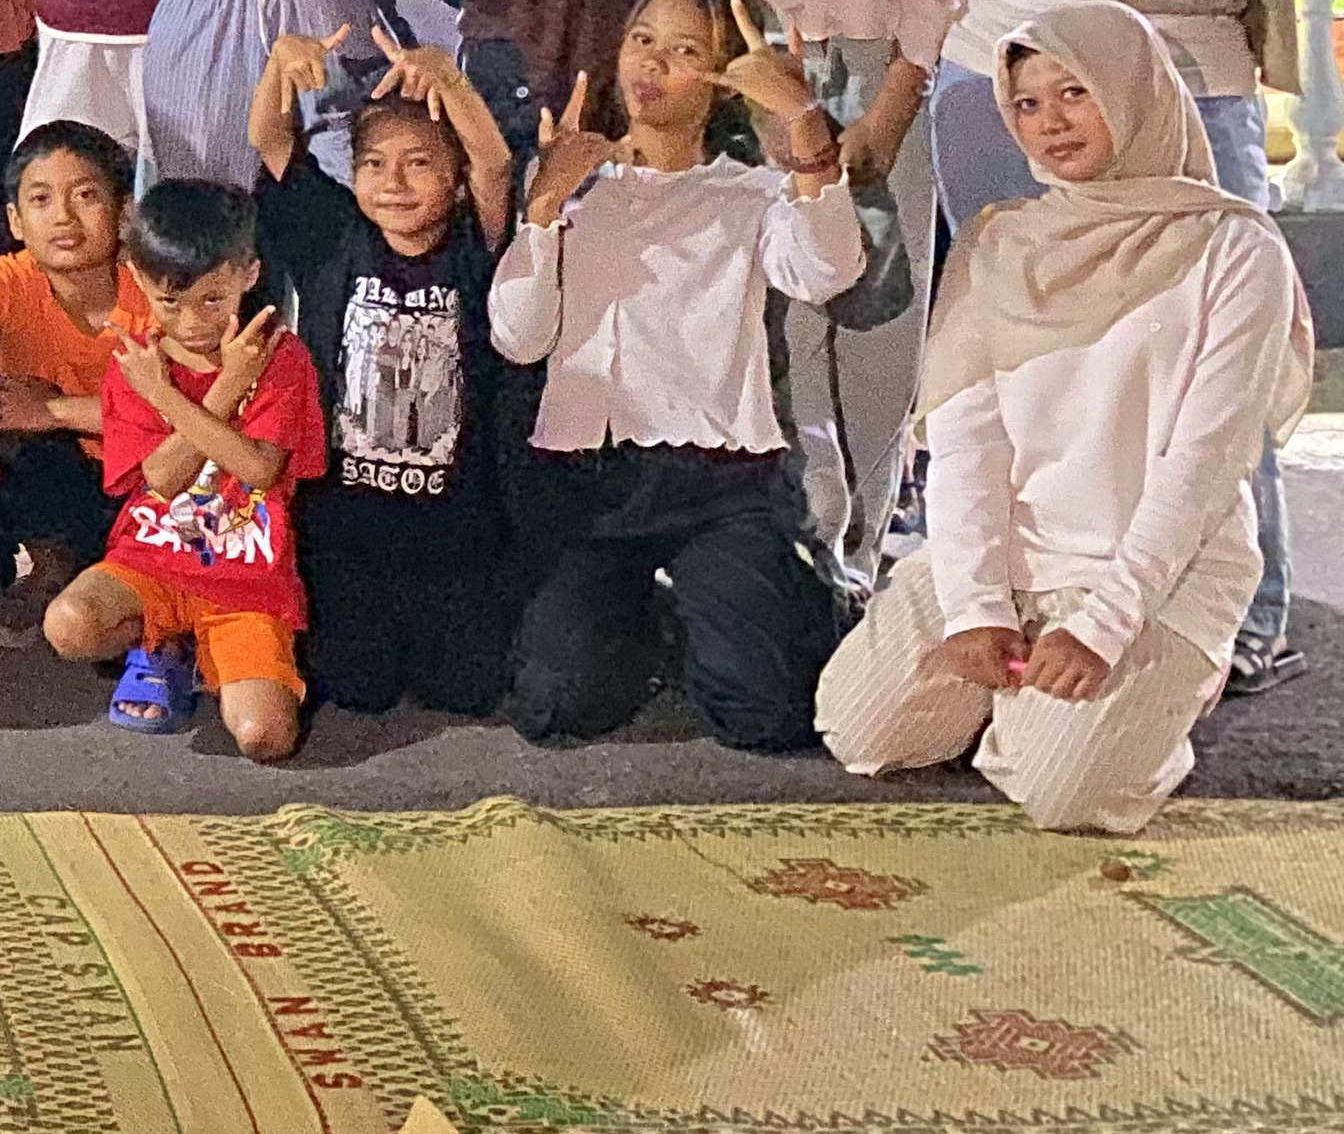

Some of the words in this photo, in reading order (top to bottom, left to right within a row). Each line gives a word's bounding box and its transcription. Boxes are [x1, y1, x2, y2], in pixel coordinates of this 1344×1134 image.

[27, 895, 93, 947] CAP
[179, 860, 283, 959] BRAND
[266, 995, 363, 1090] SWAN
